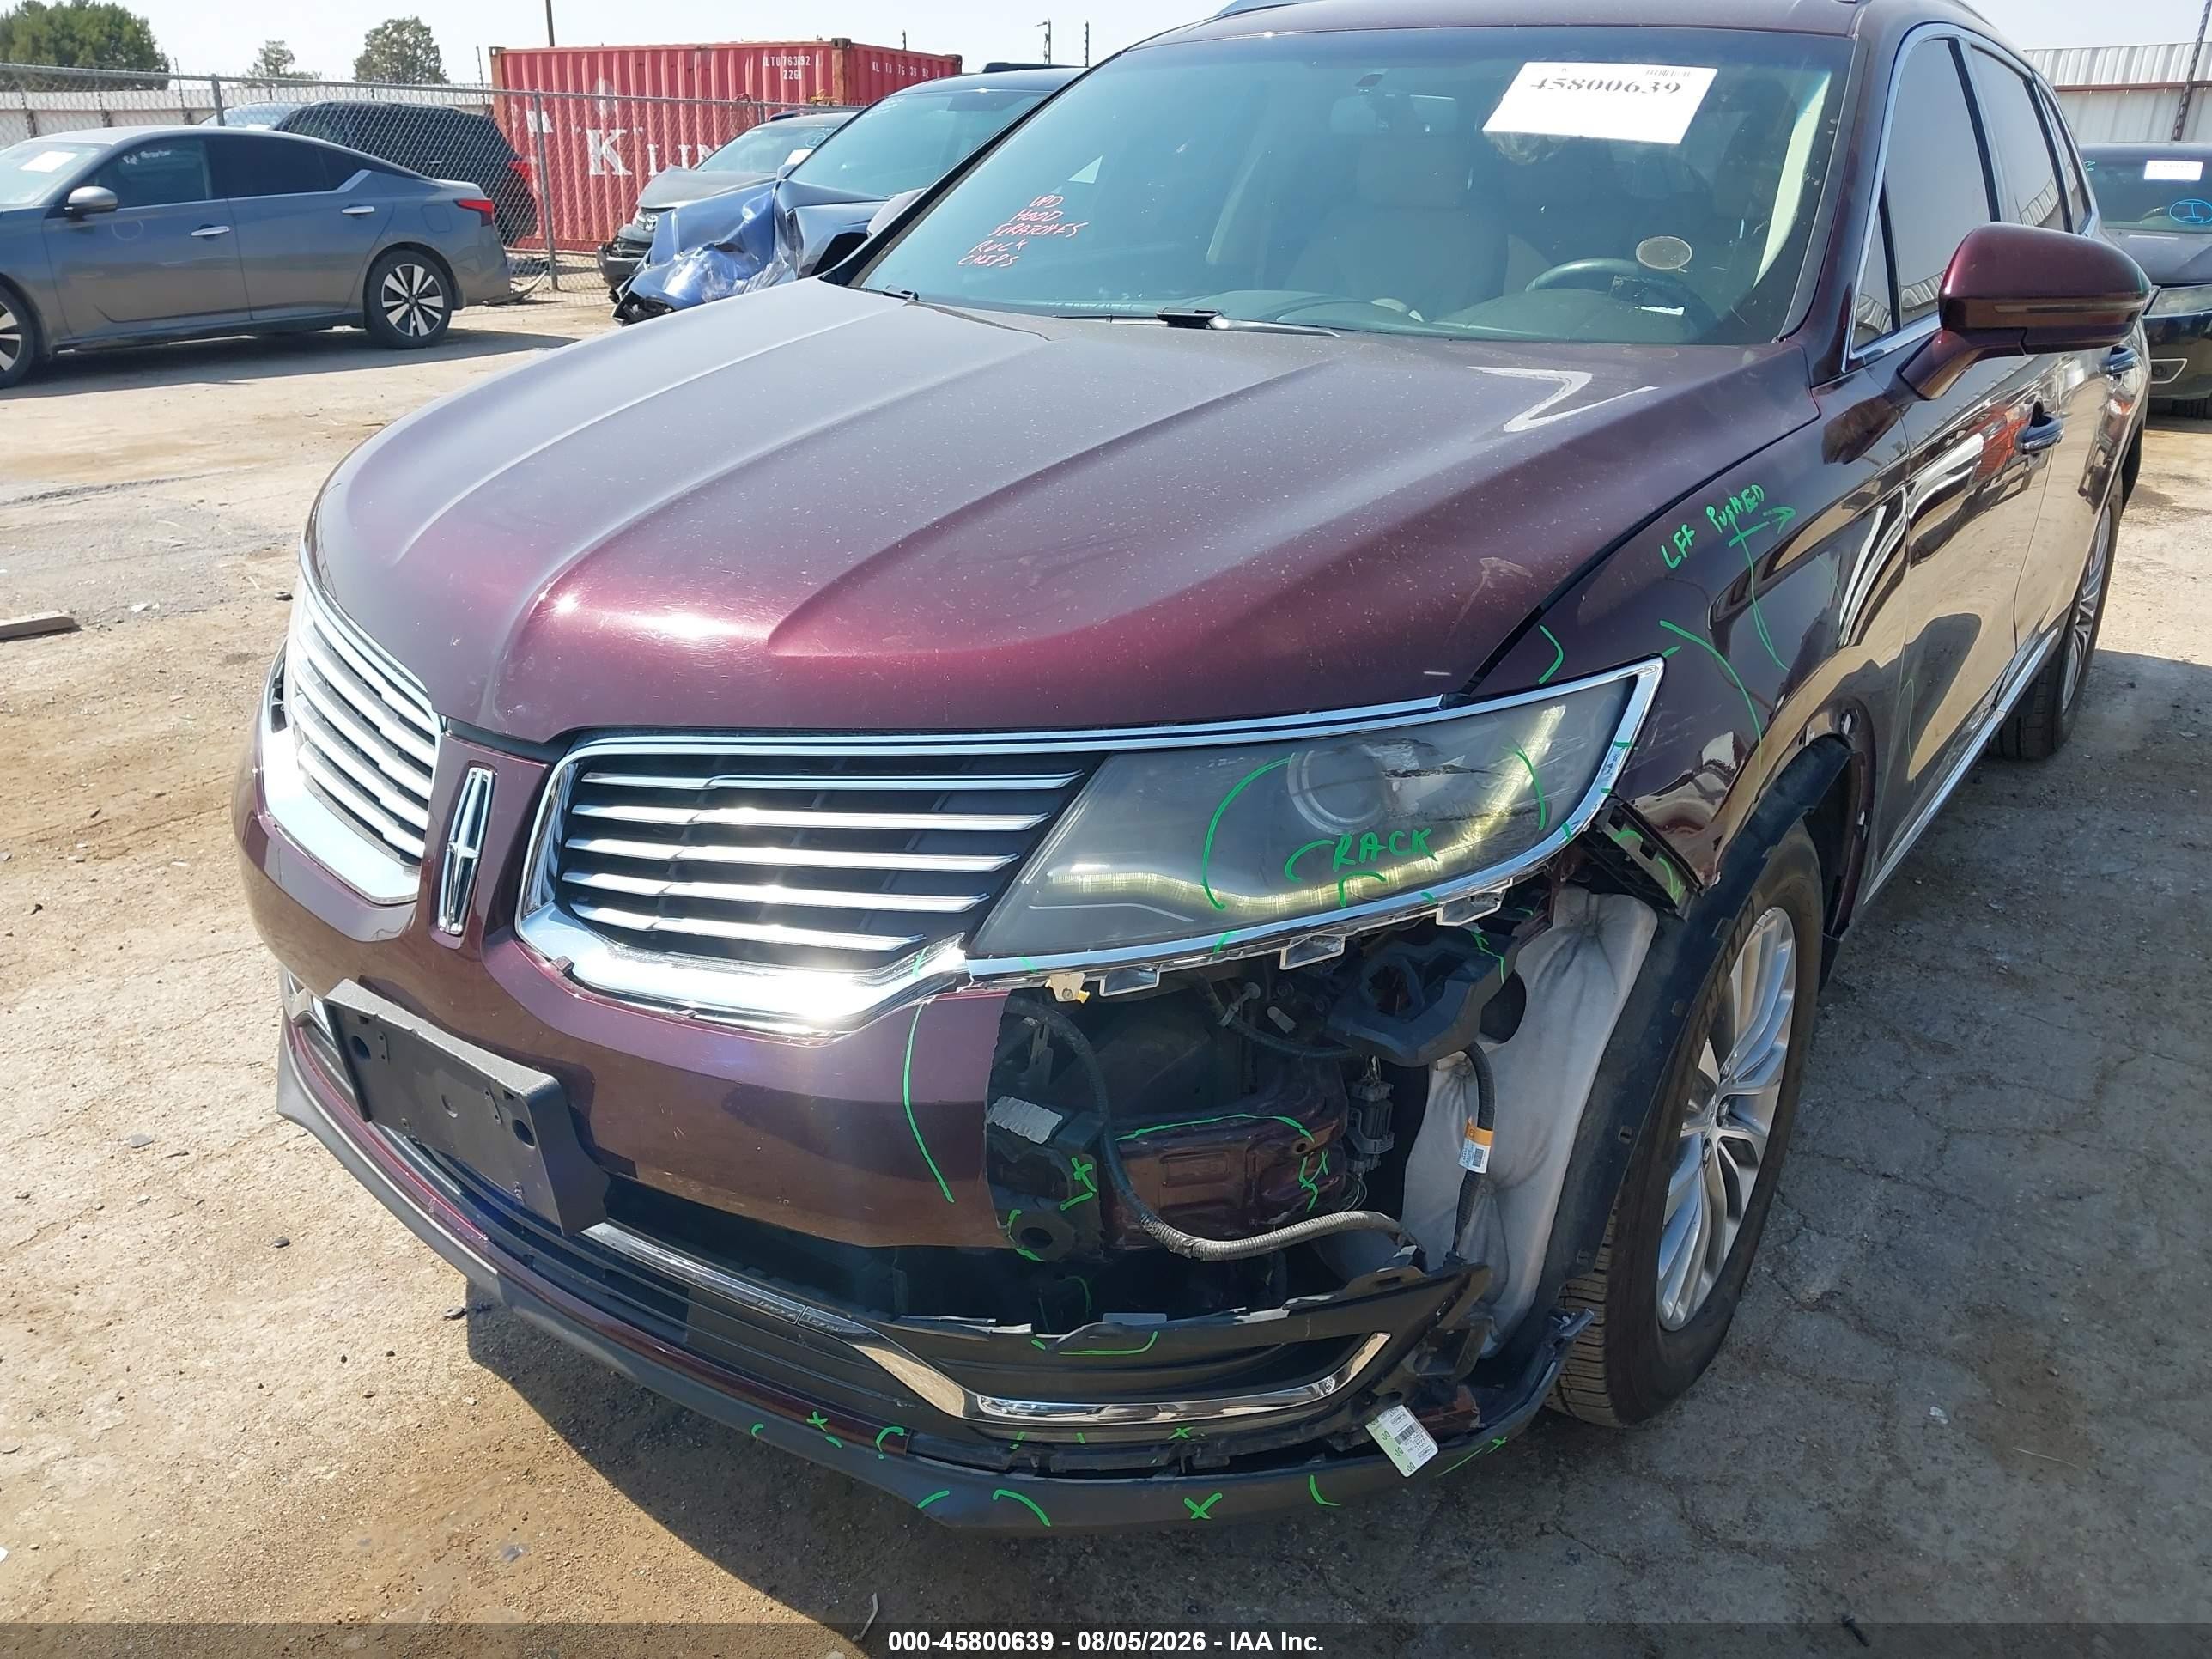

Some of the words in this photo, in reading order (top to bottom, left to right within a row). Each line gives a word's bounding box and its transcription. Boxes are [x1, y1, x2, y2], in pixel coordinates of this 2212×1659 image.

[1531, 78, 1681, 94] 45800639
[1008, 209, 1064, 223] HOOD
[1284, 827, 1439, 883] CRACK
